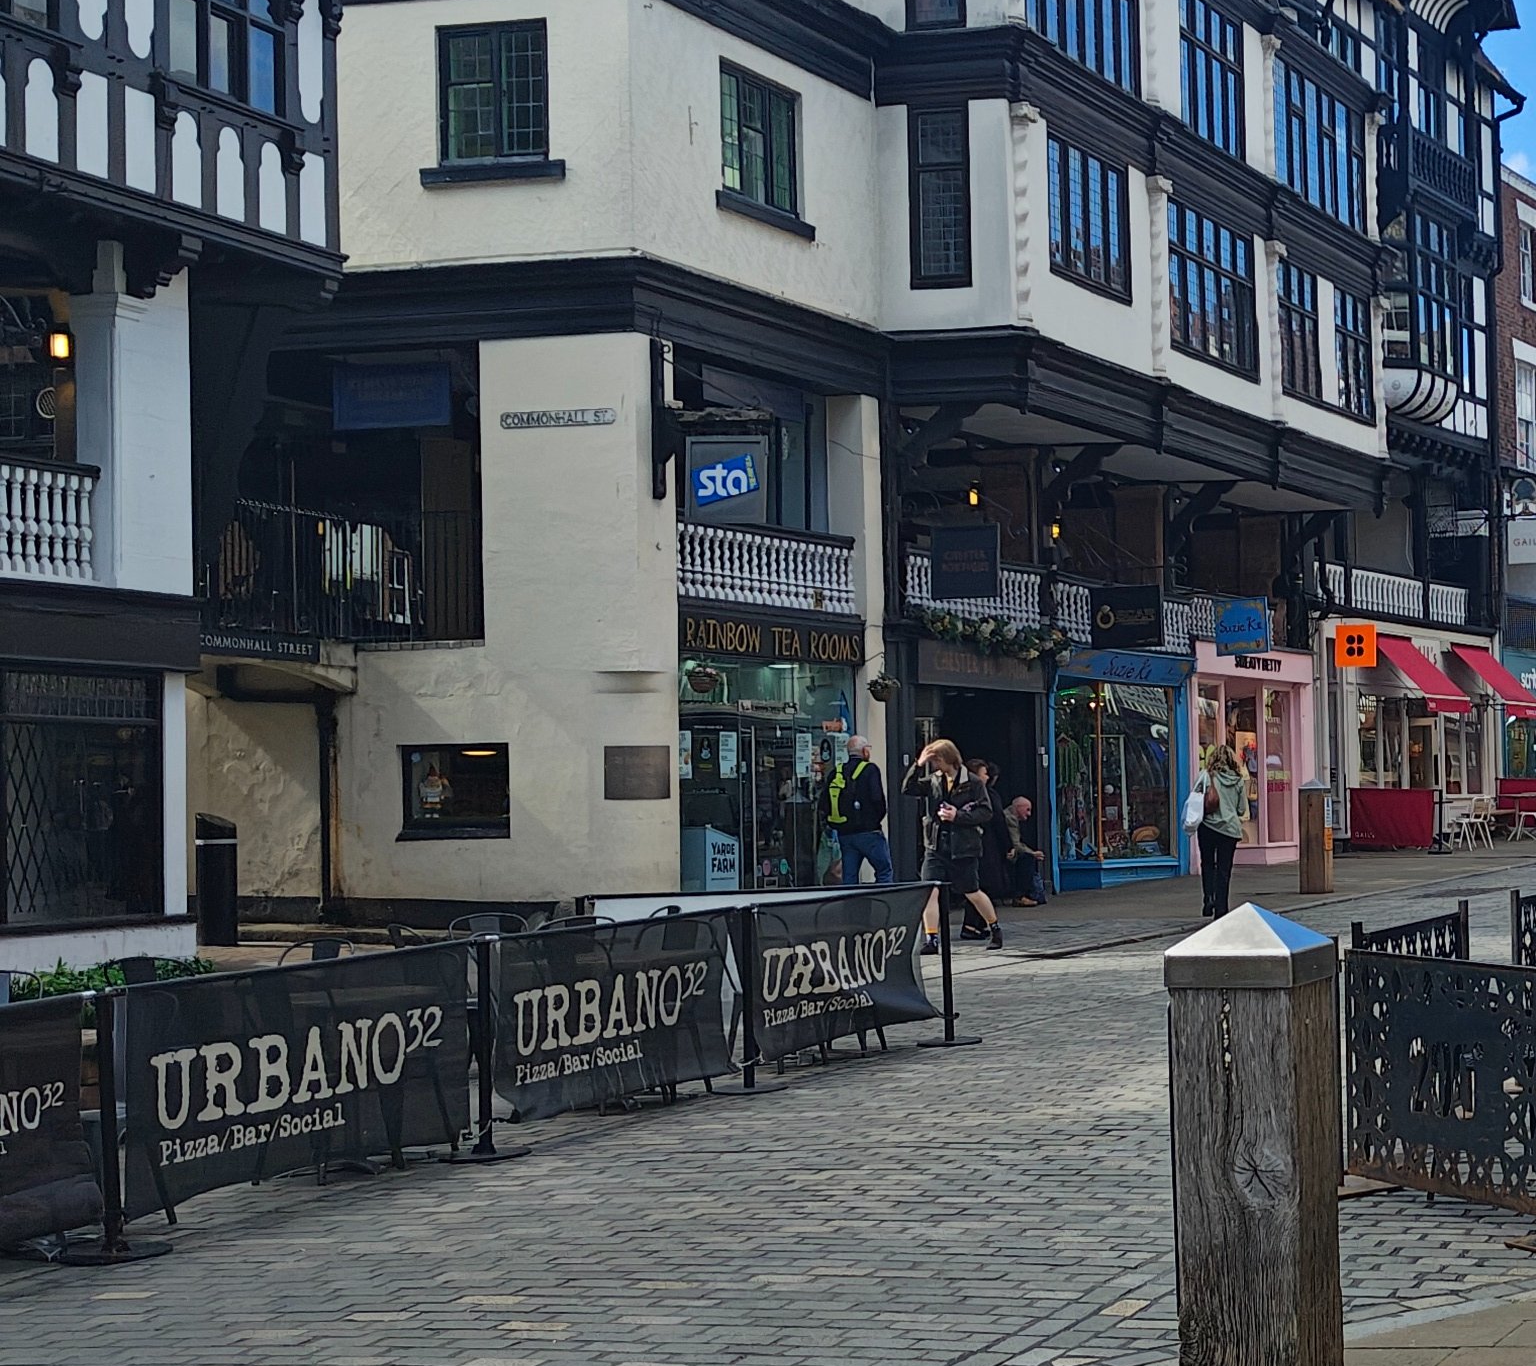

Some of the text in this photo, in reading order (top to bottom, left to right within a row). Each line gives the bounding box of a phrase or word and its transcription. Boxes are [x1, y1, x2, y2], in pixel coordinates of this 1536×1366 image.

[504, 411, 588, 426] COMMONHALL
[698, 464, 748, 496] sta
[278, 642, 313, 655] STREET
[686, 618, 860, 661] RAINBOW TEA ROOMS
[711, 842, 735, 856] YARDE
[711, 857, 736, 873] FARM
[764, 990, 873, 1027] Pizza/Bar/Social
[515, 1039, 642, 1087] Pizza/Bar/Social
[159, 1103, 346, 1167] Pizza/Bar/Social
